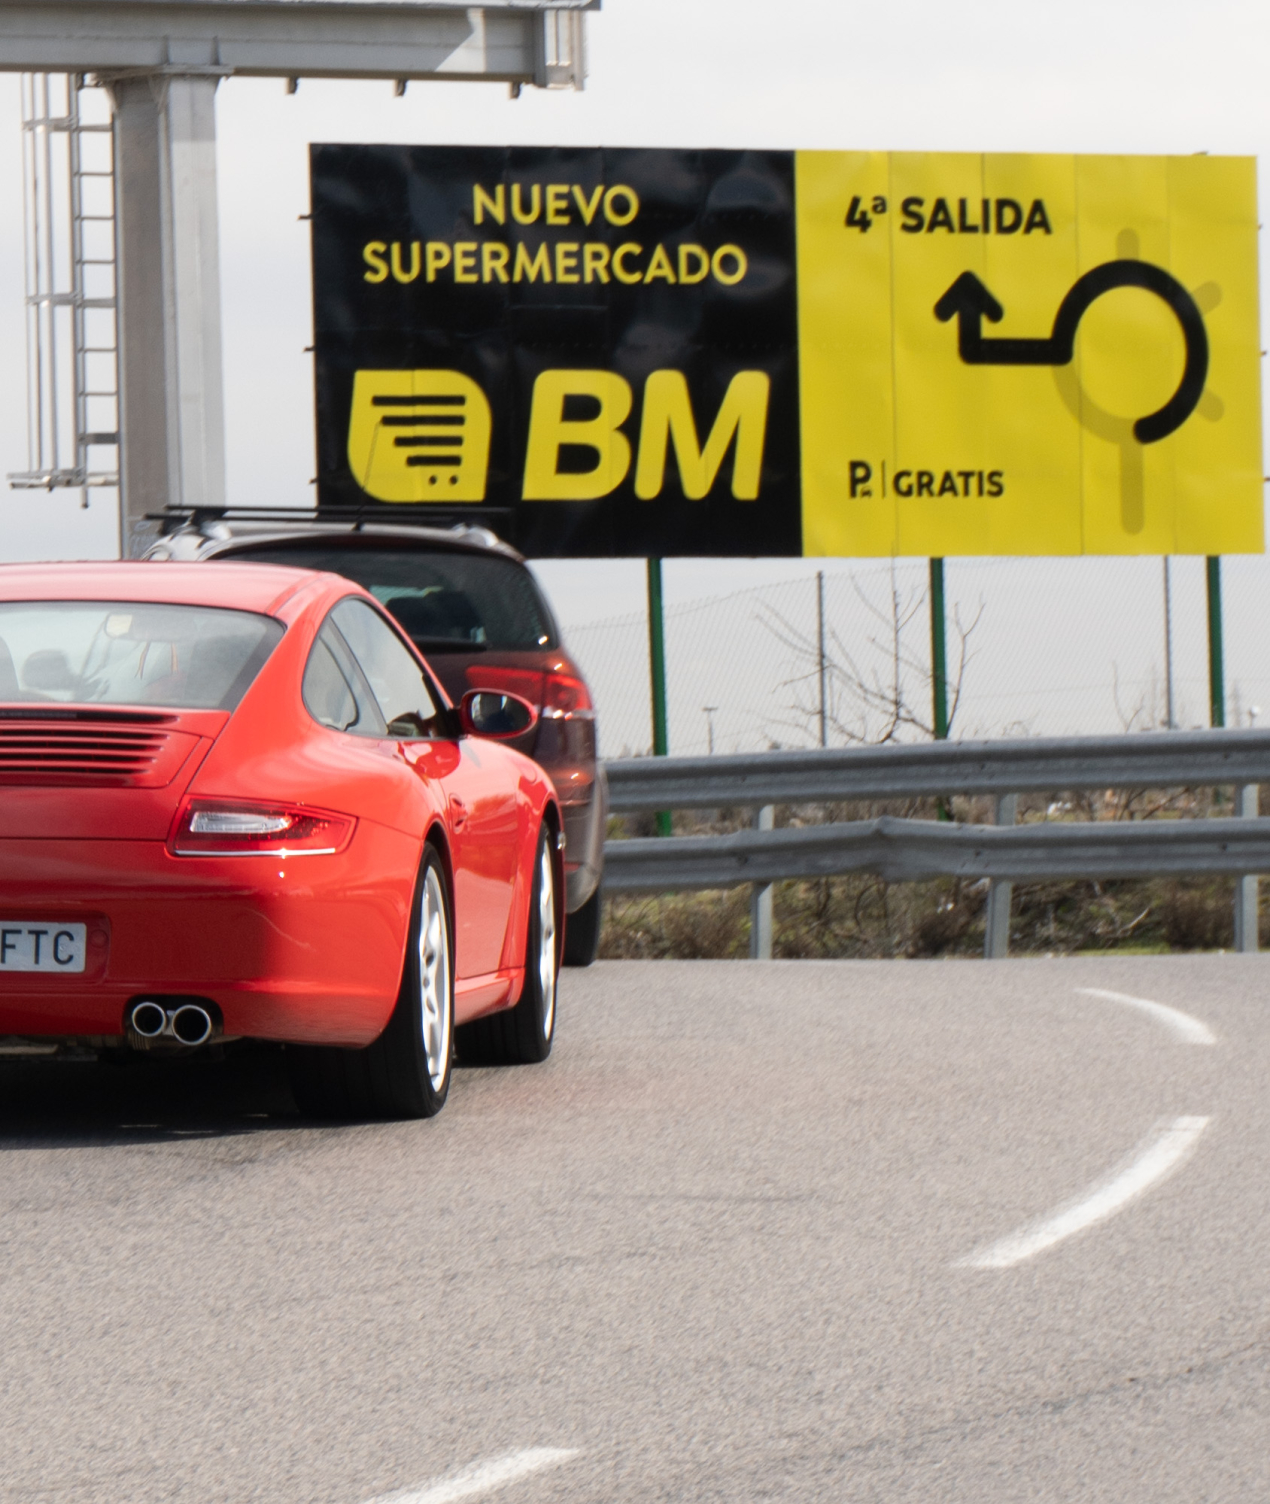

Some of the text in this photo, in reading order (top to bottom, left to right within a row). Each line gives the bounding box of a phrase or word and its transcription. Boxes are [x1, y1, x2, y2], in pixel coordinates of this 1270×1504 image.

[473, 183, 640, 226] NUEVO
[899, 196, 1053, 235] SALIDA
[363, 241, 748, 285] SUPERMERCADO
[521, 368, 771, 501] BM
[893, 470, 1004, 498] GRATIS
[0, 929, 75, 965] FTC
